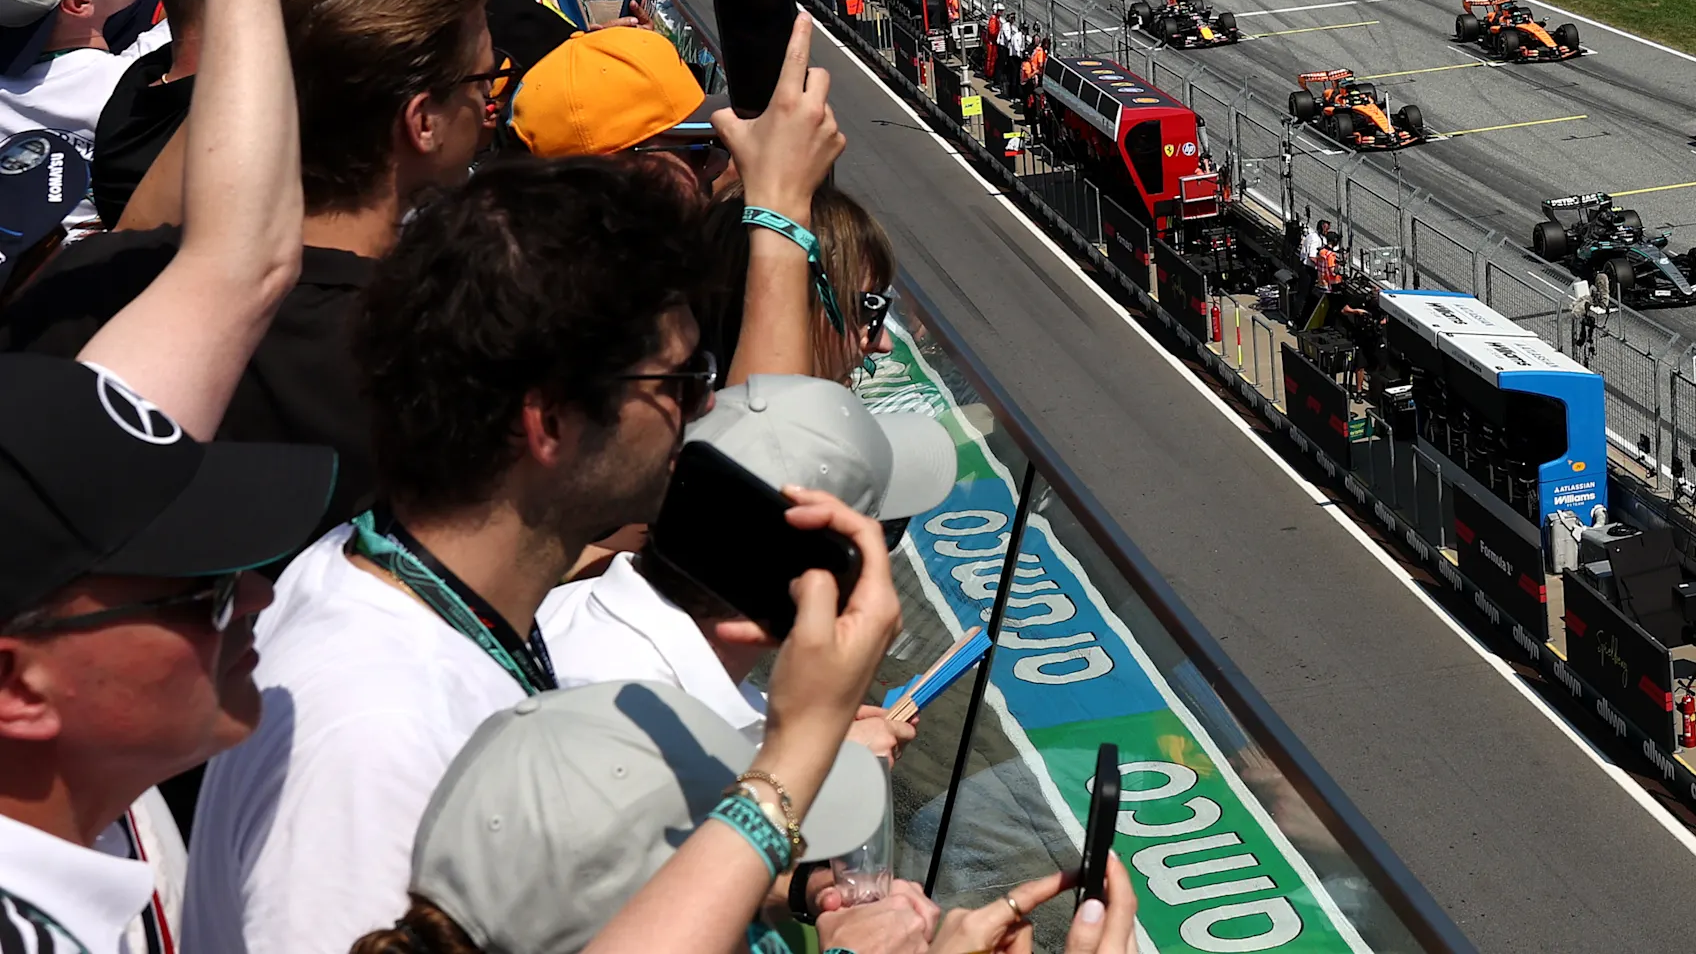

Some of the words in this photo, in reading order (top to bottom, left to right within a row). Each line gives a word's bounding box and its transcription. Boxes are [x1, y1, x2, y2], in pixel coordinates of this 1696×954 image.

[1184, 144, 1196, 156] hp
[47, 152, 64, 203] KOMATSU
[1289, 425, 1308, 453] allwyn
[1316, 448, 1336, 478] allwyn
[1344, 474, 1366, 505] allwyn
[1554, 493, 1596, 505] Williams
[1560, 482, 1595, 492] ATLASSIAN
[1374, 500, 1397, 533] allwyn
[1406, 529, 1429, 561] allwyn
[1480, 539, 1506, 572] Formula
[1438, 558, 1463, 592] allwyn
[924, 509, 1114, 684] aramco
[1474, 590, 1500, 625] allwyn
[1512, 623, 1540, 660] allwyn
[1552, 660, 1582, 698] allwyn
[1596, 697, 1627, 737] allwyn
[1642, 738, 1676, 781] allwyn
[1085, 761, 1303, 954] amco
